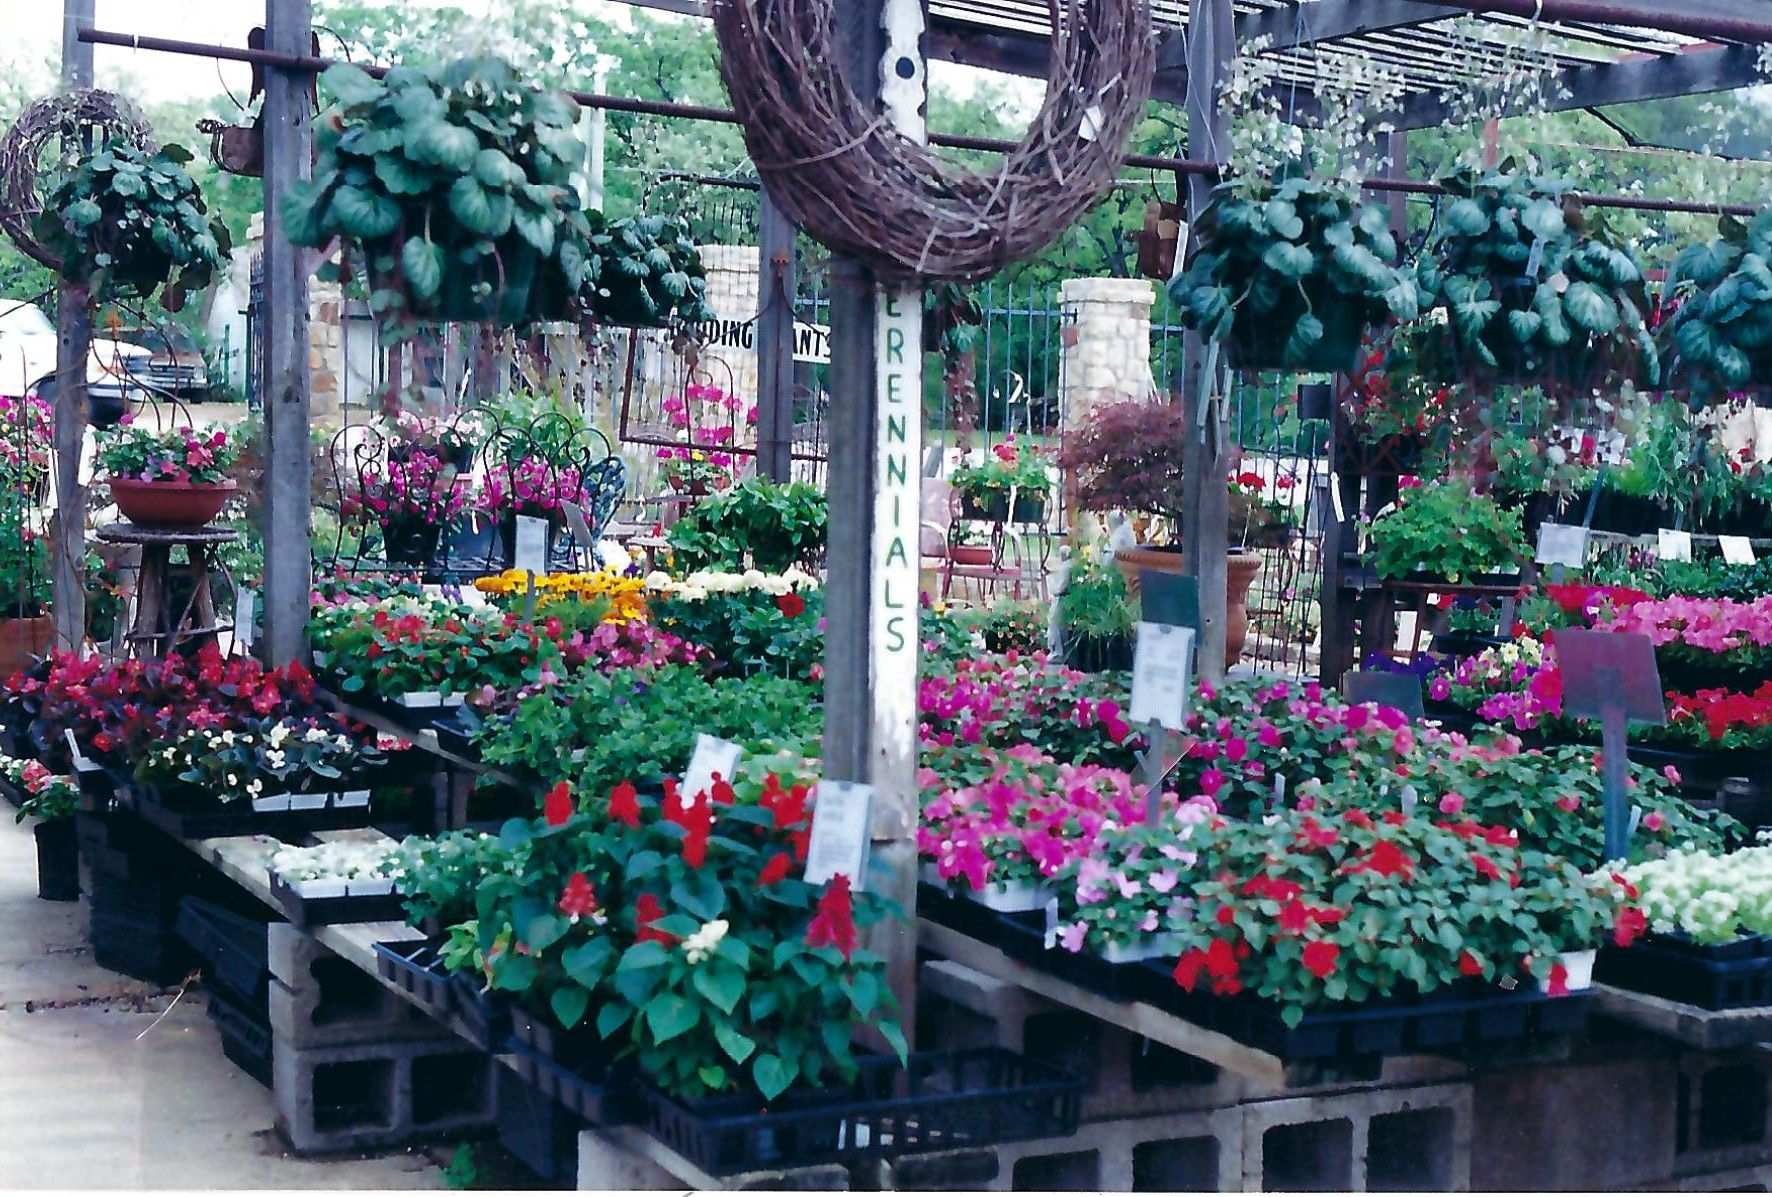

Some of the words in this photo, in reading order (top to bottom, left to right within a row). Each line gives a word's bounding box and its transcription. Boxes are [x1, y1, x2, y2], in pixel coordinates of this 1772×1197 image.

[676, 318, 754, 349] DING
[791, 327, 831, 358] ANTS
[885, 291, 907, 652] ERENNIALS
